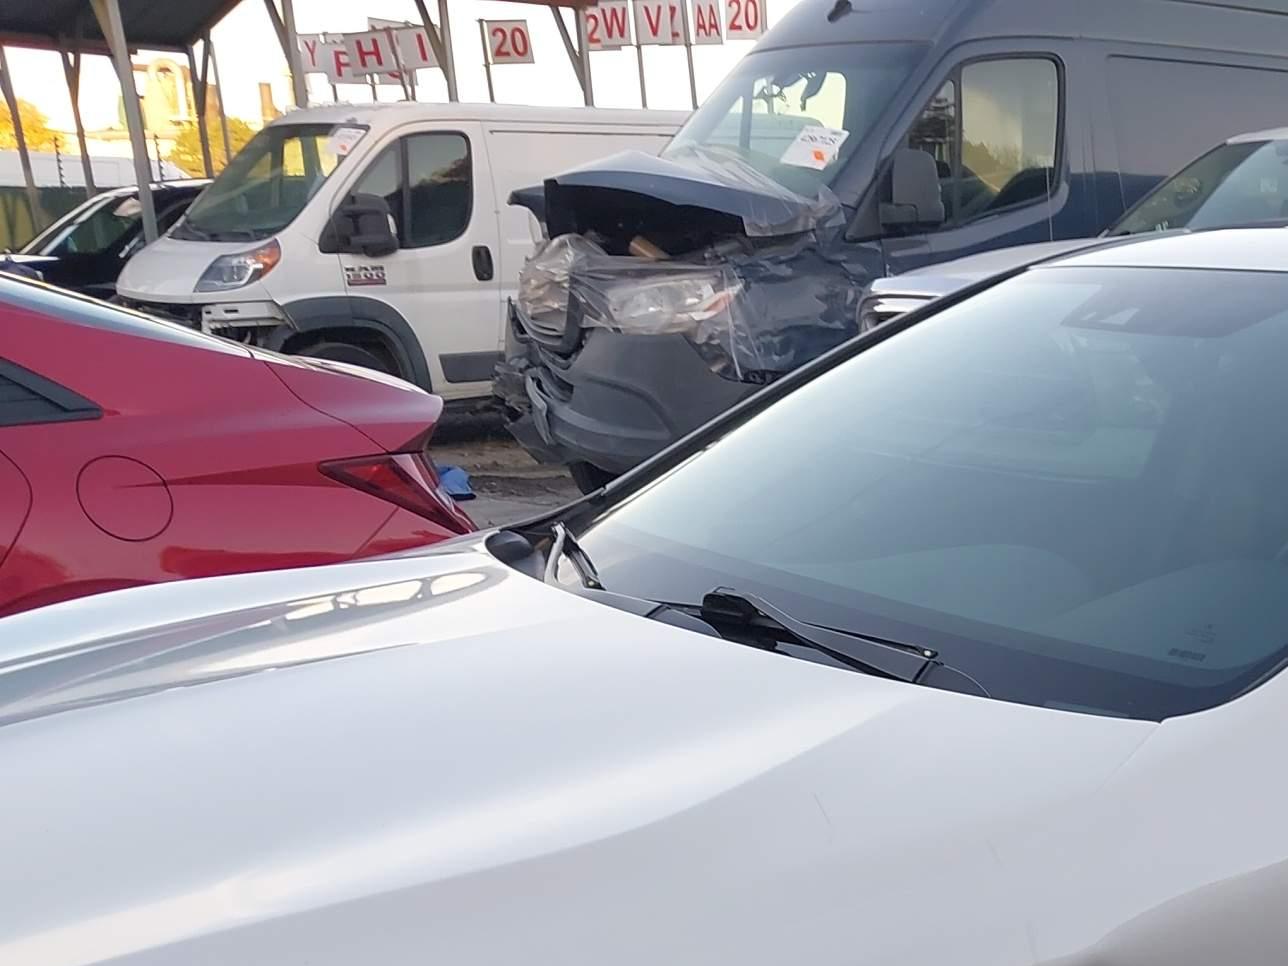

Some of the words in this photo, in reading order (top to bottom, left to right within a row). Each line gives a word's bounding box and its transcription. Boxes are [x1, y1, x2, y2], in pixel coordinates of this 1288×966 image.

[601, 7, 627, 40] W
[643, 5, 662, 38] V
[696, 4, 721, 38] AA
[727, 0, 759, 31] 20
[304, 40, 317, 67] Y
[355, 37, 384, 69] H
[491, 26, 530, 58] 20
